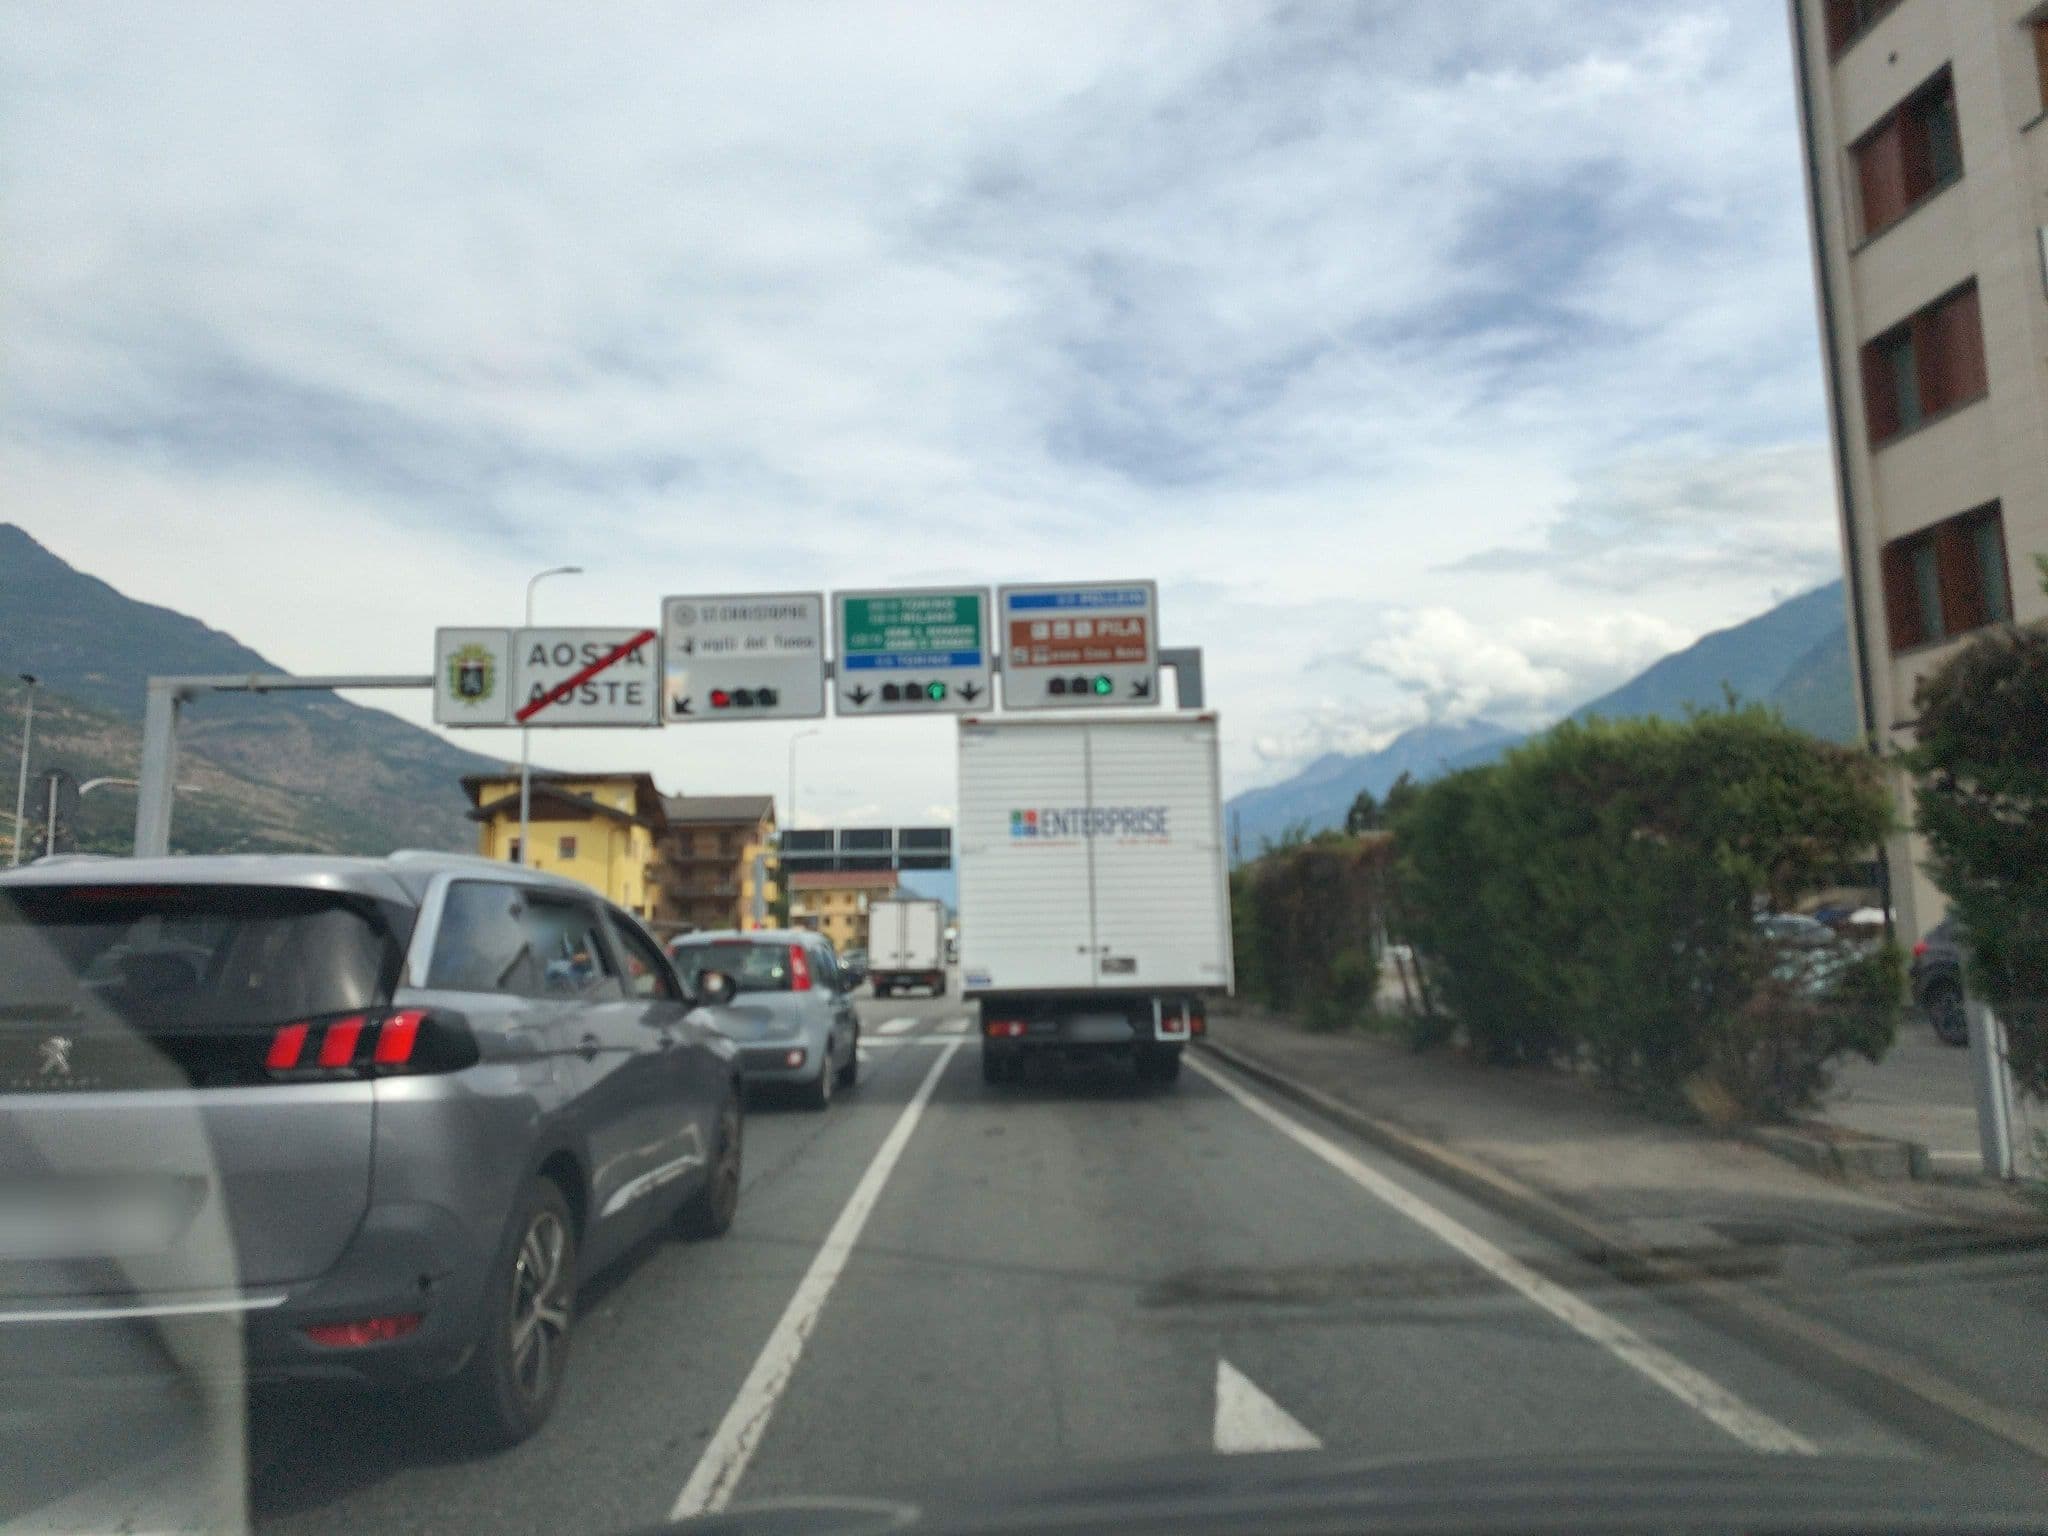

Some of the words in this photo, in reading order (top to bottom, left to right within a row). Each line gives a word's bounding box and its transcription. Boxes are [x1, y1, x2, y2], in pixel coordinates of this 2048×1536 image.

[1096, 620, 1142, 637] PILA
[528, 643, 643, 666] AOSTA
[529, 681, 642, 705] AOSTE
[1040, 807, 1168, 837] ENTERPRISE
